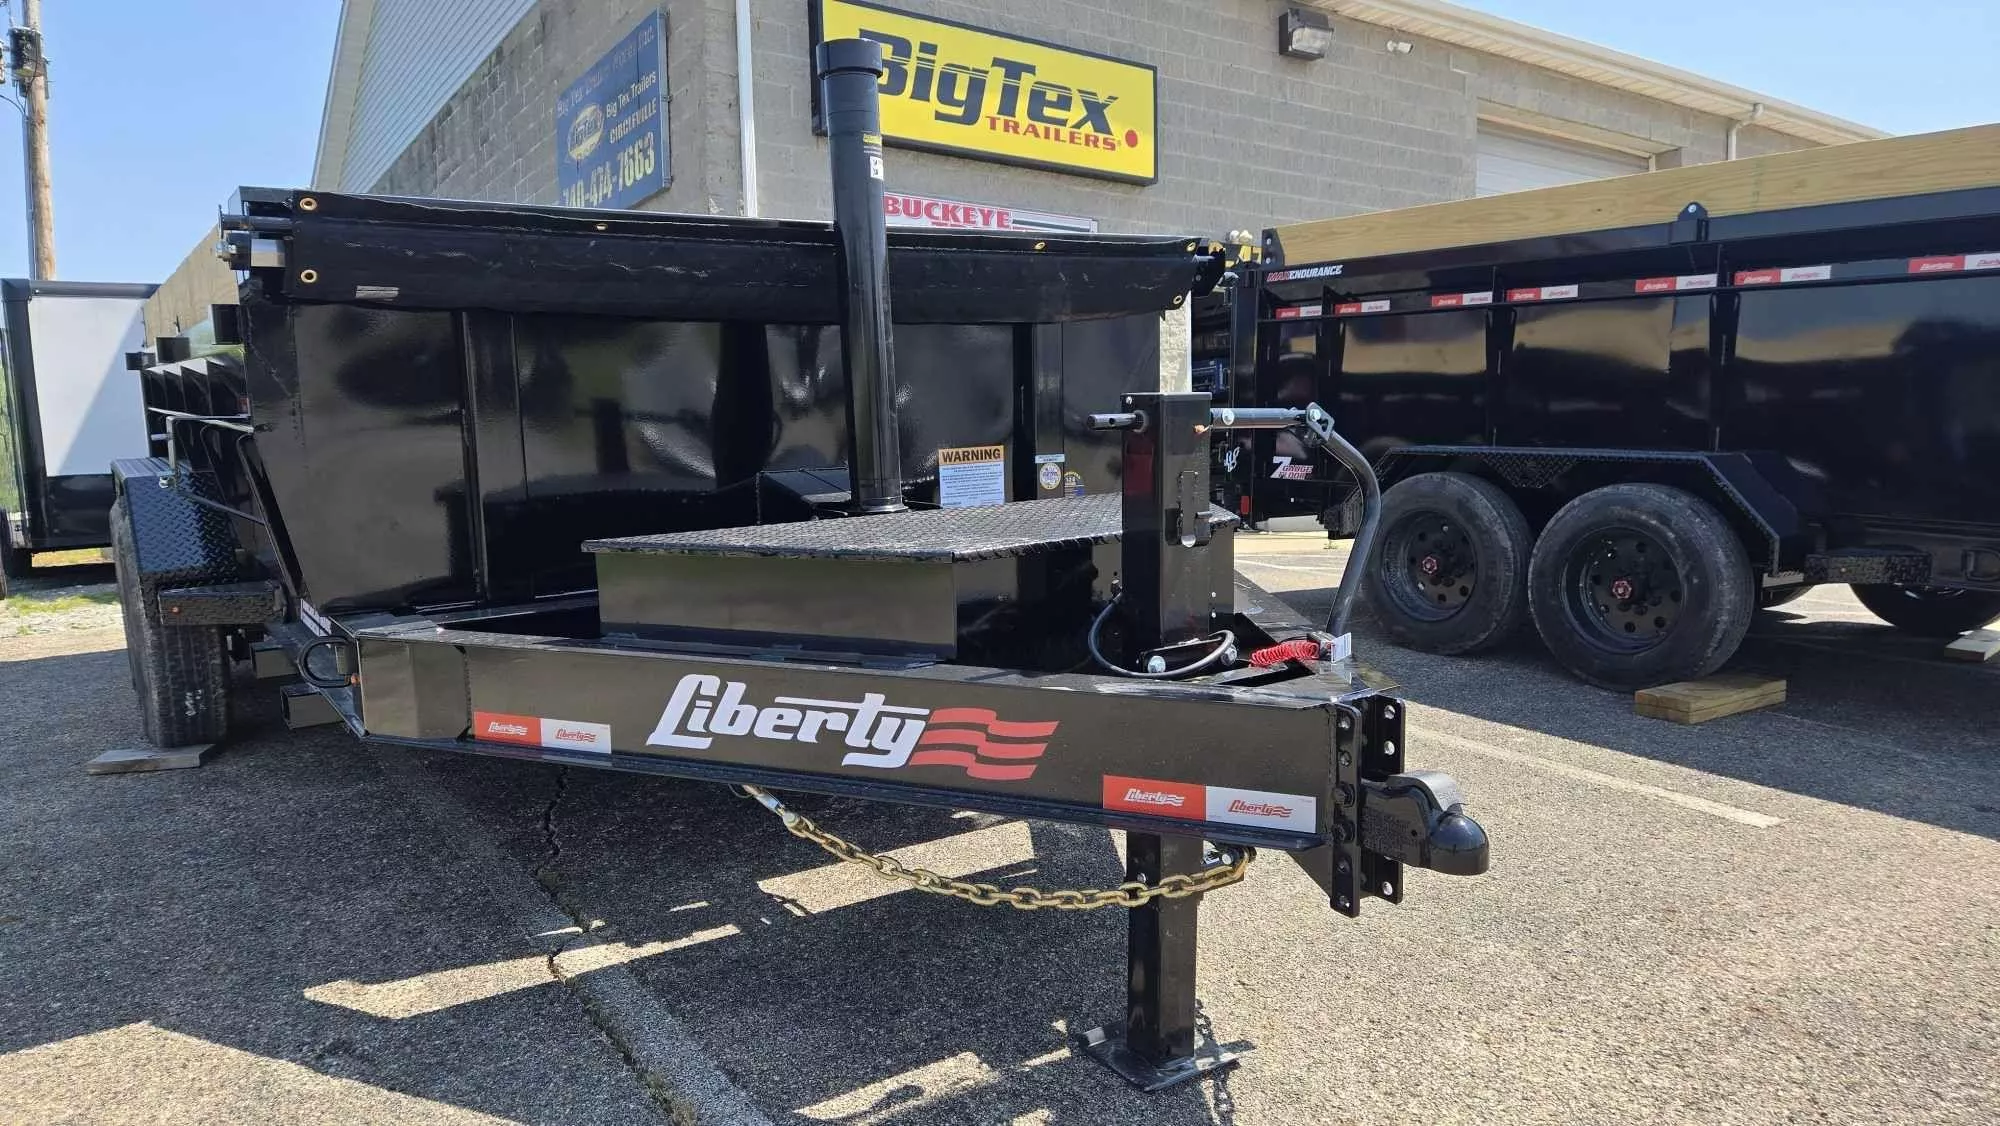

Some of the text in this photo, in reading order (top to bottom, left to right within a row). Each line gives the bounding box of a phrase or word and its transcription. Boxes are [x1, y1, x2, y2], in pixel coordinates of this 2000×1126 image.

[606, 71, 657, 119] Big Tex Trailers
[609, 97, 657, 144] CIRCLEVILLE
[985, 115, 1117, 152] TRAILERS
[883, 195, 1011, 229] BUCKEYE
[942, 448, 1001, 463] WARNING
[487, 721, 585, 742] Liberty Liberty
[645, 673, 931, 769] Liberty
[1123, 787, 1274, 817] Liberty Liberty
